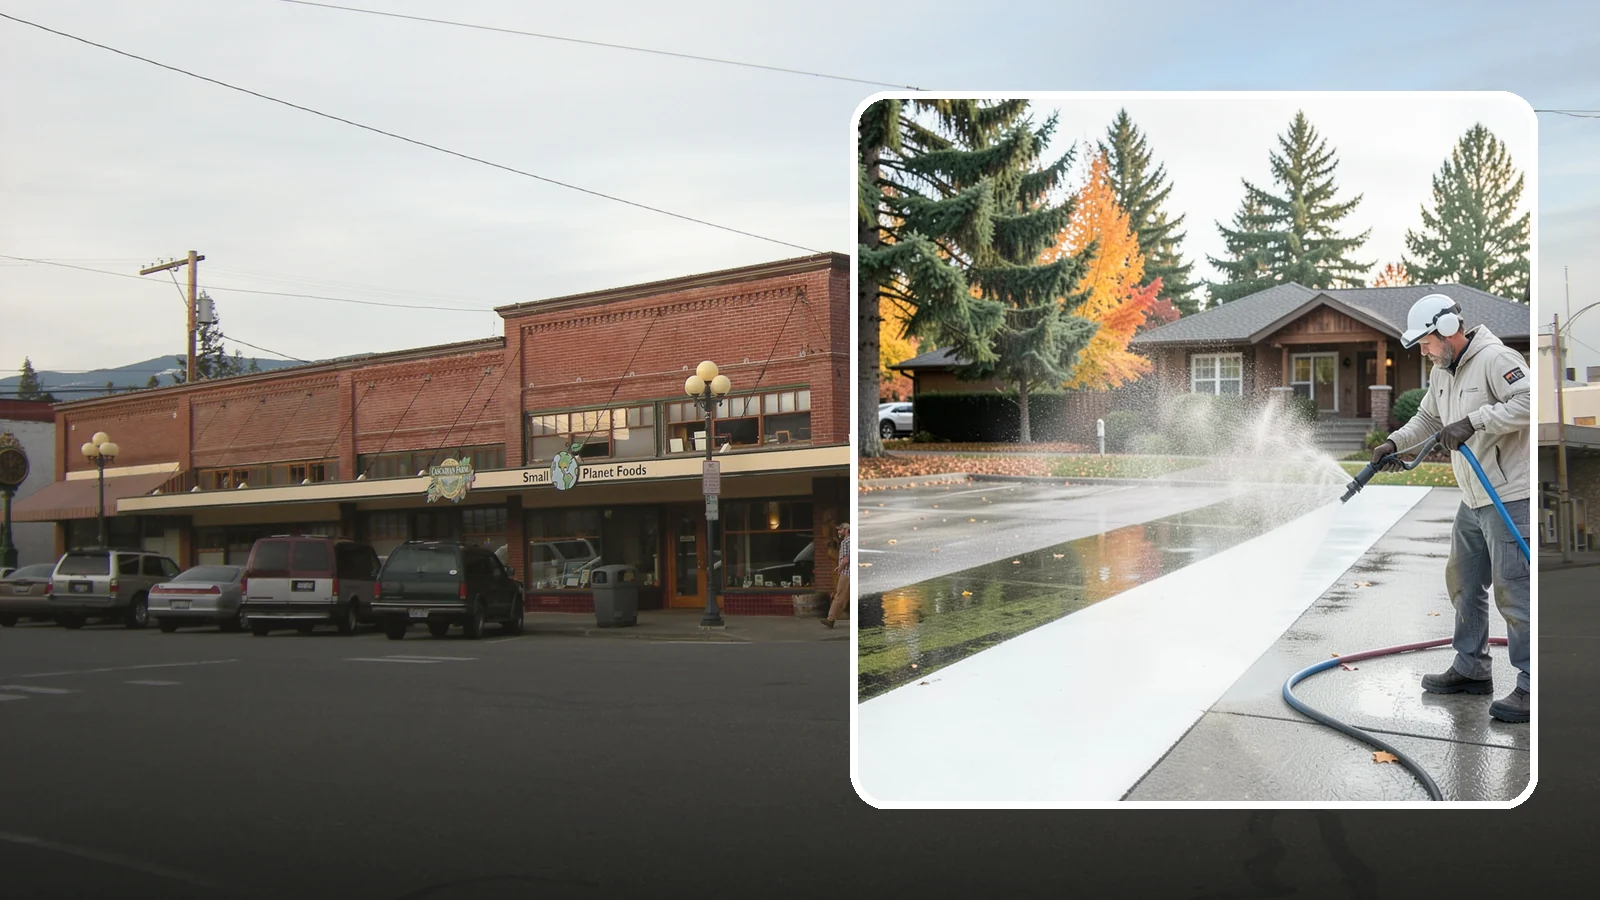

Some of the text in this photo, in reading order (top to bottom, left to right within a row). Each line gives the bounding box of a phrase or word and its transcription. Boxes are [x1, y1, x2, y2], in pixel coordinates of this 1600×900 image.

[523, 464, 647, 483] Small Planet Foods
